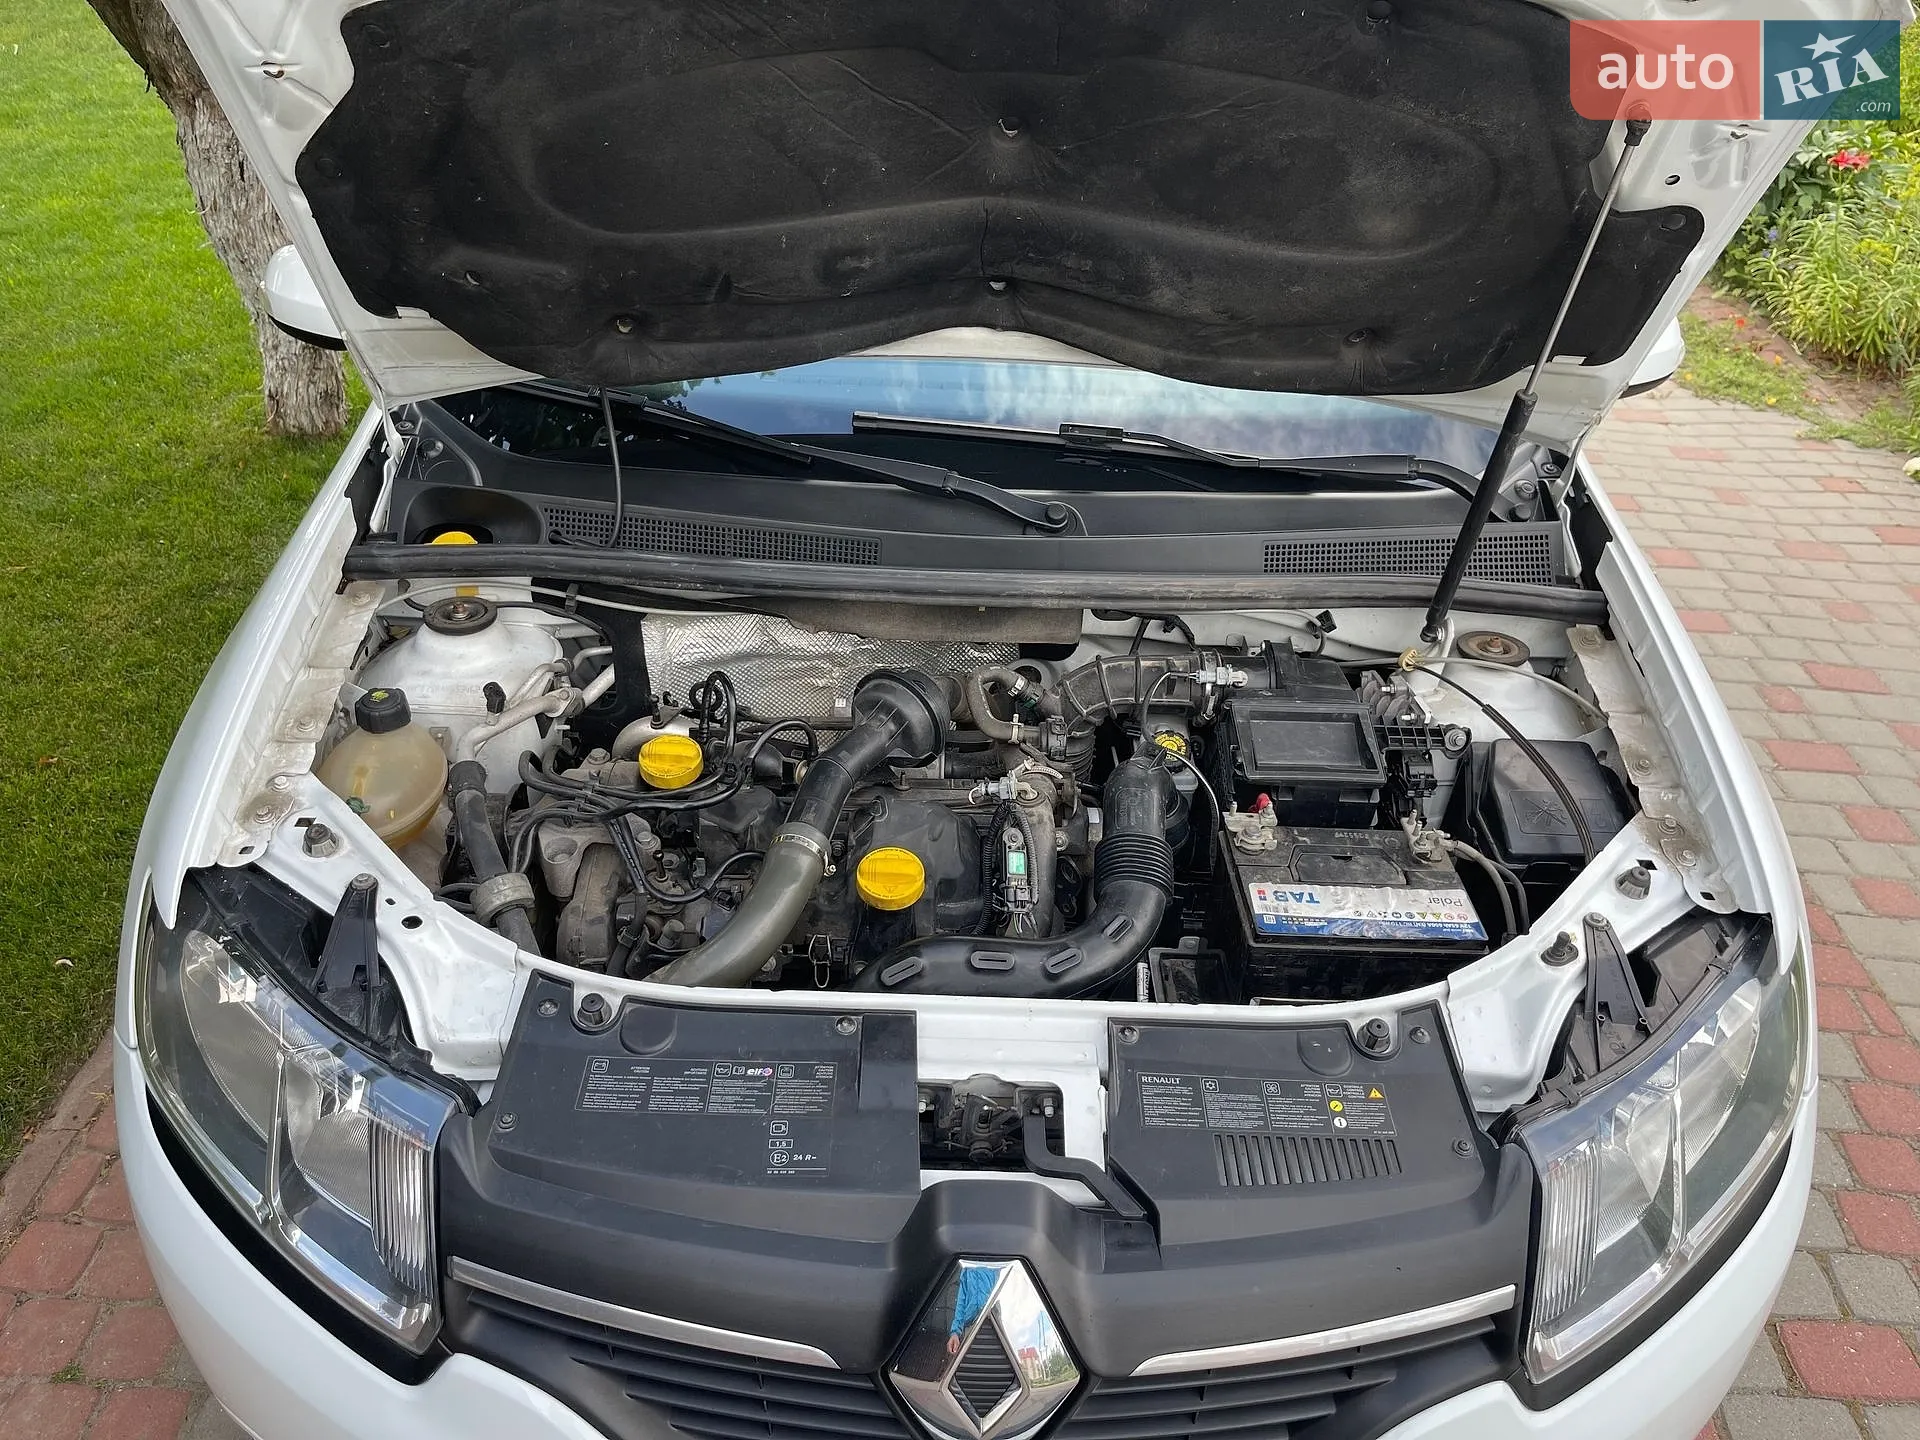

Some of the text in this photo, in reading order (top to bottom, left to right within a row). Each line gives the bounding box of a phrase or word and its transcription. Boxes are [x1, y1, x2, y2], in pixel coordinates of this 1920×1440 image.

[1272, 889, 1321, 905] TAB
[1427, 895, 1463, 907] Polar
[746, 1067, 765, 1076] elf
[1141, 1076, 1180, 1084] RENAULT
[773, 1153, 787, 1163] E2
